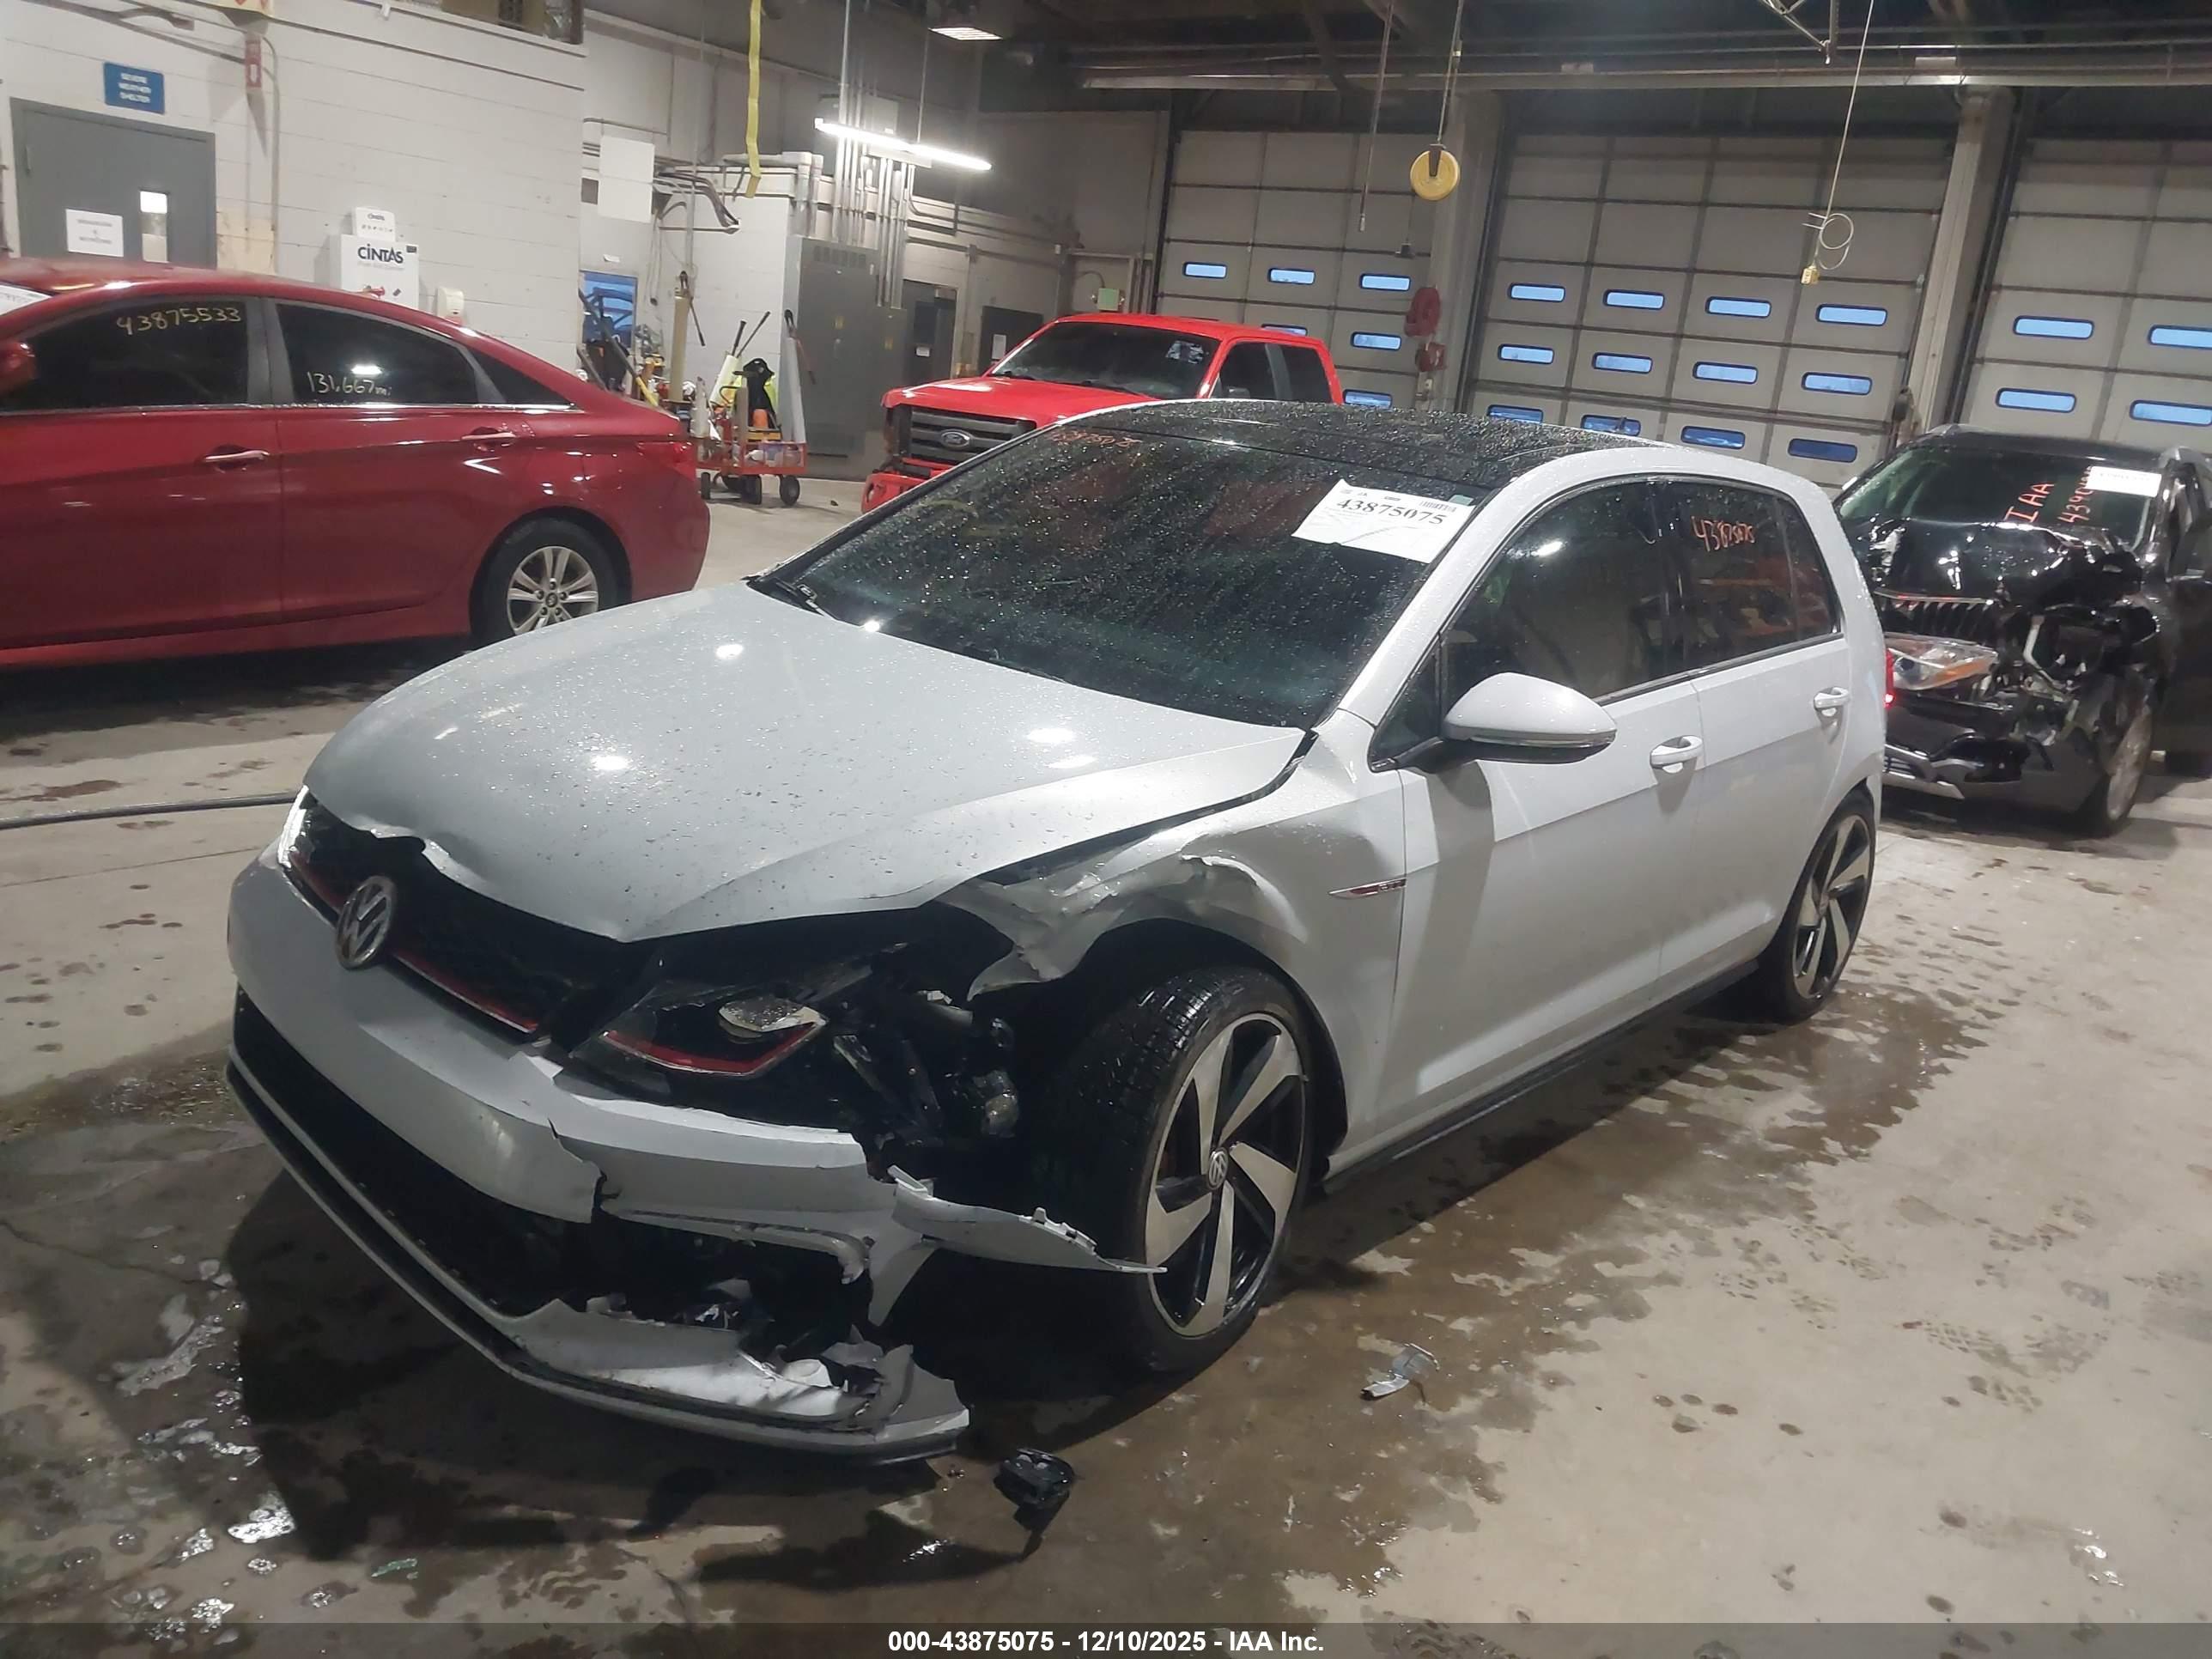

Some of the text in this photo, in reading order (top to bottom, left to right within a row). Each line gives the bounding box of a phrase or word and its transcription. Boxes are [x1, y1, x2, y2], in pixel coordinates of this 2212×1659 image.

[116, 307, 241, 335] 43875533
[1336, 498, 1449, 525] 43875075
[2003, 483, 2055, 523] IAA
